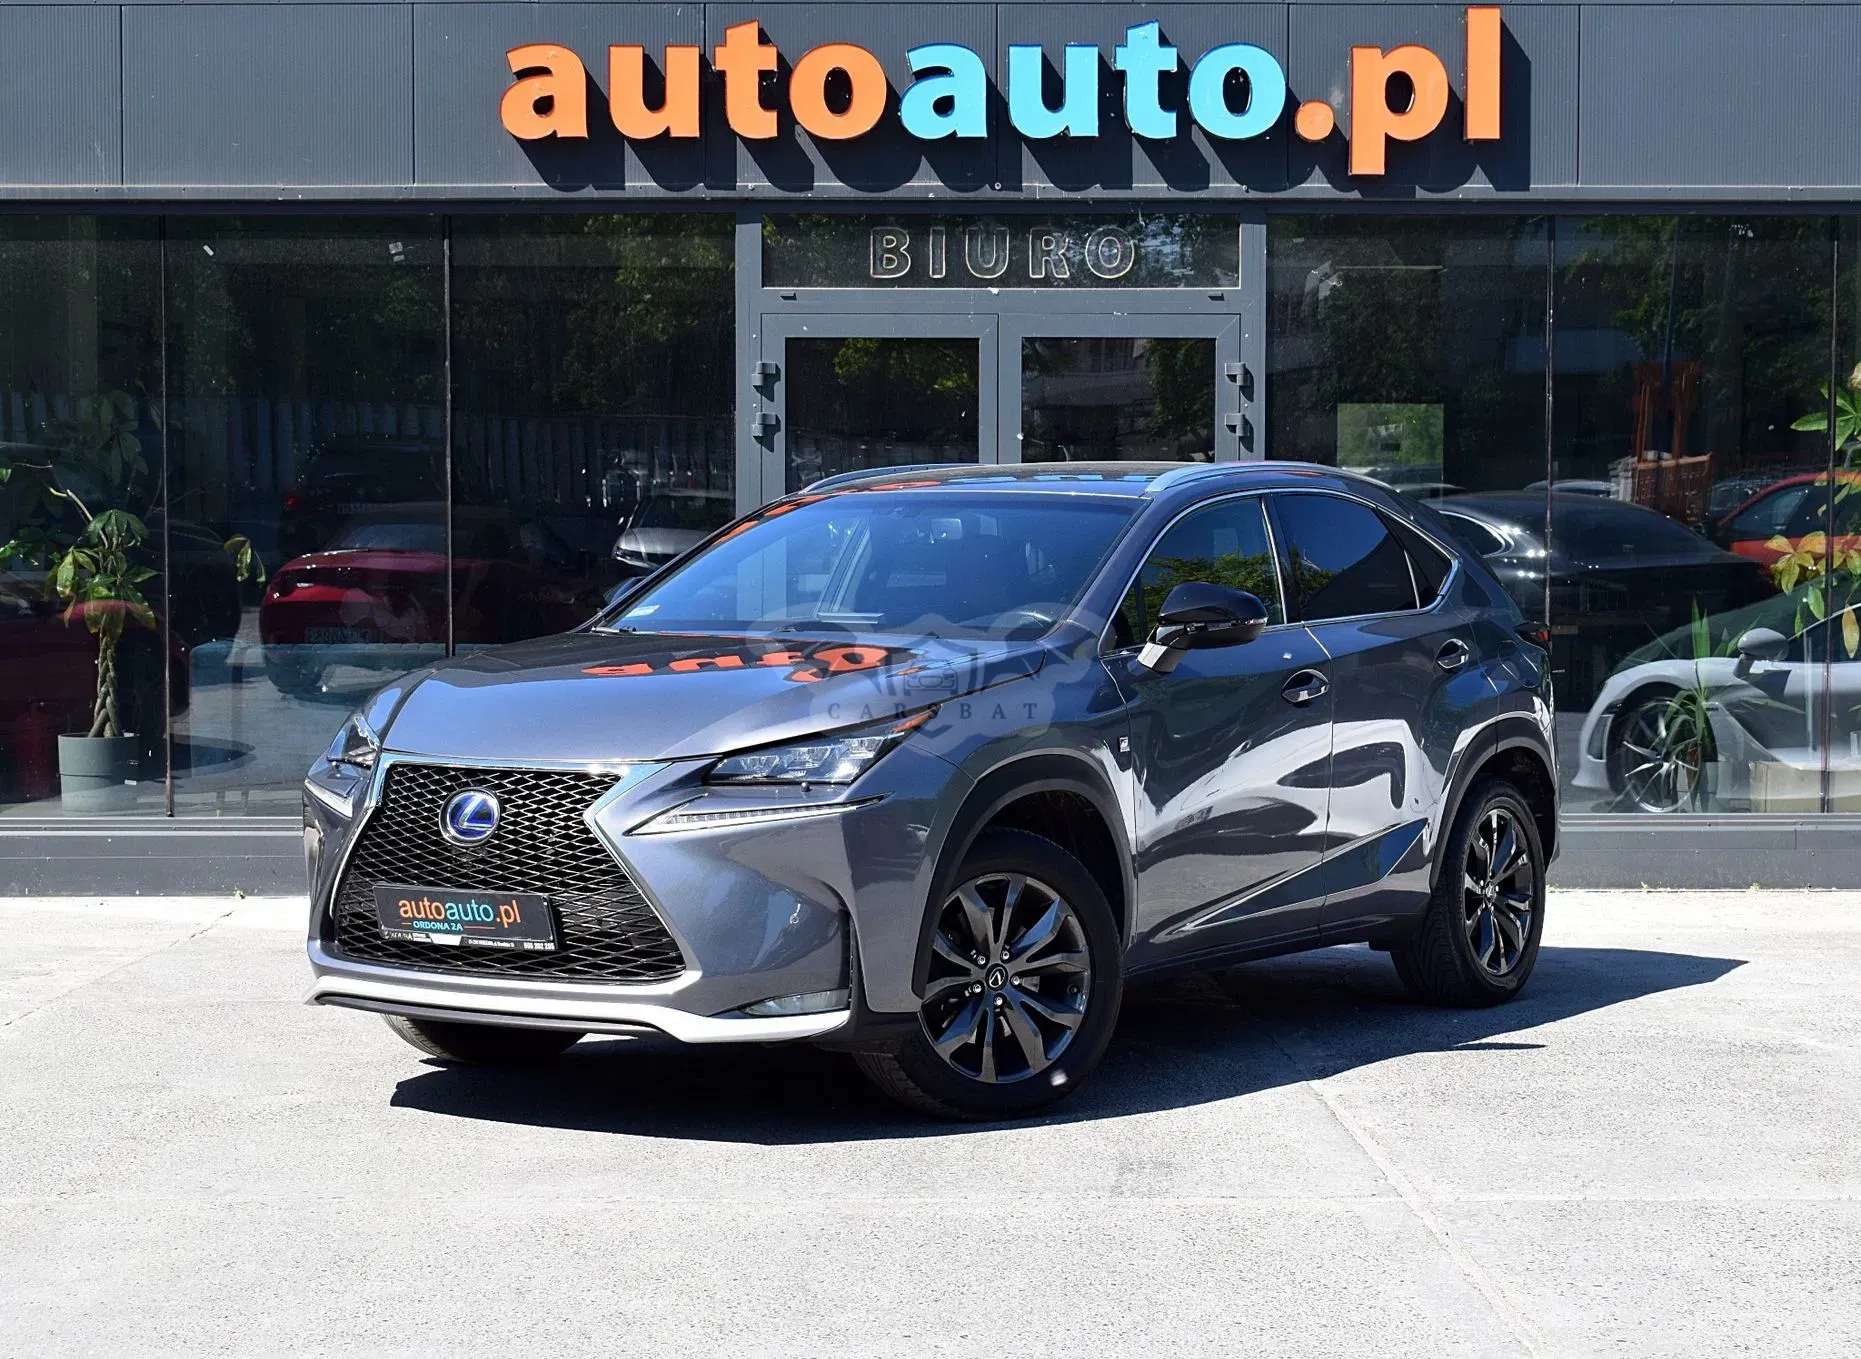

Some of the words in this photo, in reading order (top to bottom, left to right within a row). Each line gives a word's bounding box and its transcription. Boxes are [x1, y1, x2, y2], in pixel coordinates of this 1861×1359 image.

[499, 6, 1501, 175] autoauto.pl
[871, 227, 1134, 278] BIURO
[398, 897, 521, 928] autoauto.pl
[413, 921, 450, 930] ORDONA
[451, 923, 464, 931] 2A
